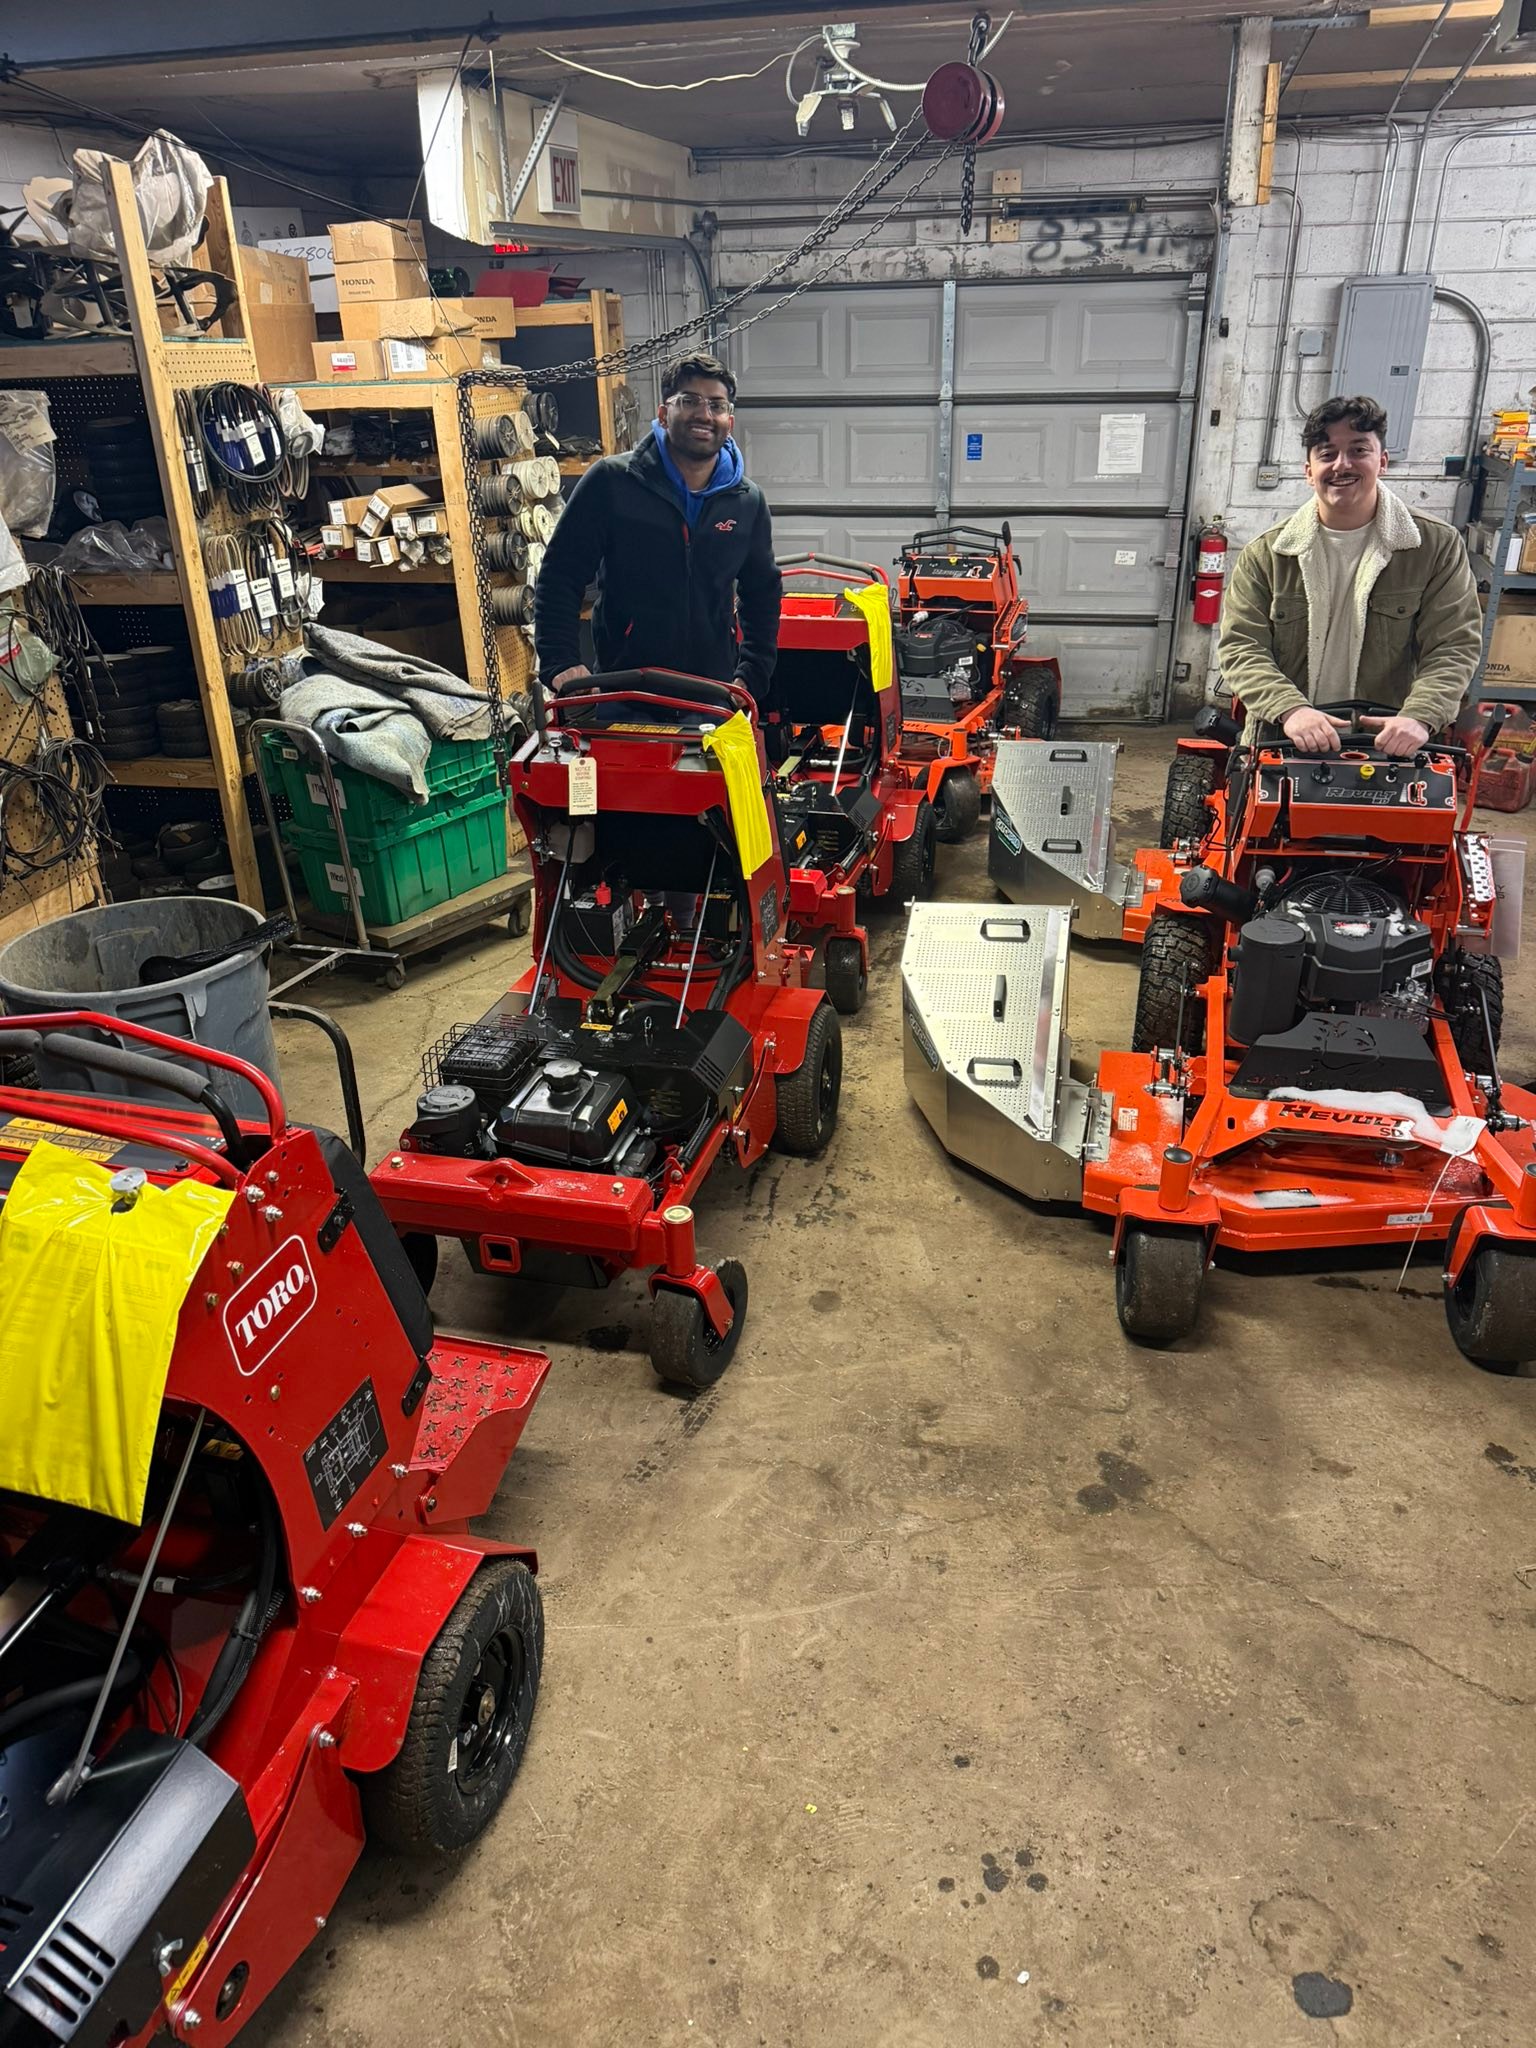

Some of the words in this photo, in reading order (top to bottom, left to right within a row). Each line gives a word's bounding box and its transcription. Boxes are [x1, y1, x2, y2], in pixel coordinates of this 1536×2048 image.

[552, 156, 576, 204] EXIT
[341, 278, 375, 286] HONDA
[474, 315, 497, 324] ONDA
[1485, 663, 1511, 672] ONDA
[235, 1264, 305, 1348] TORO
